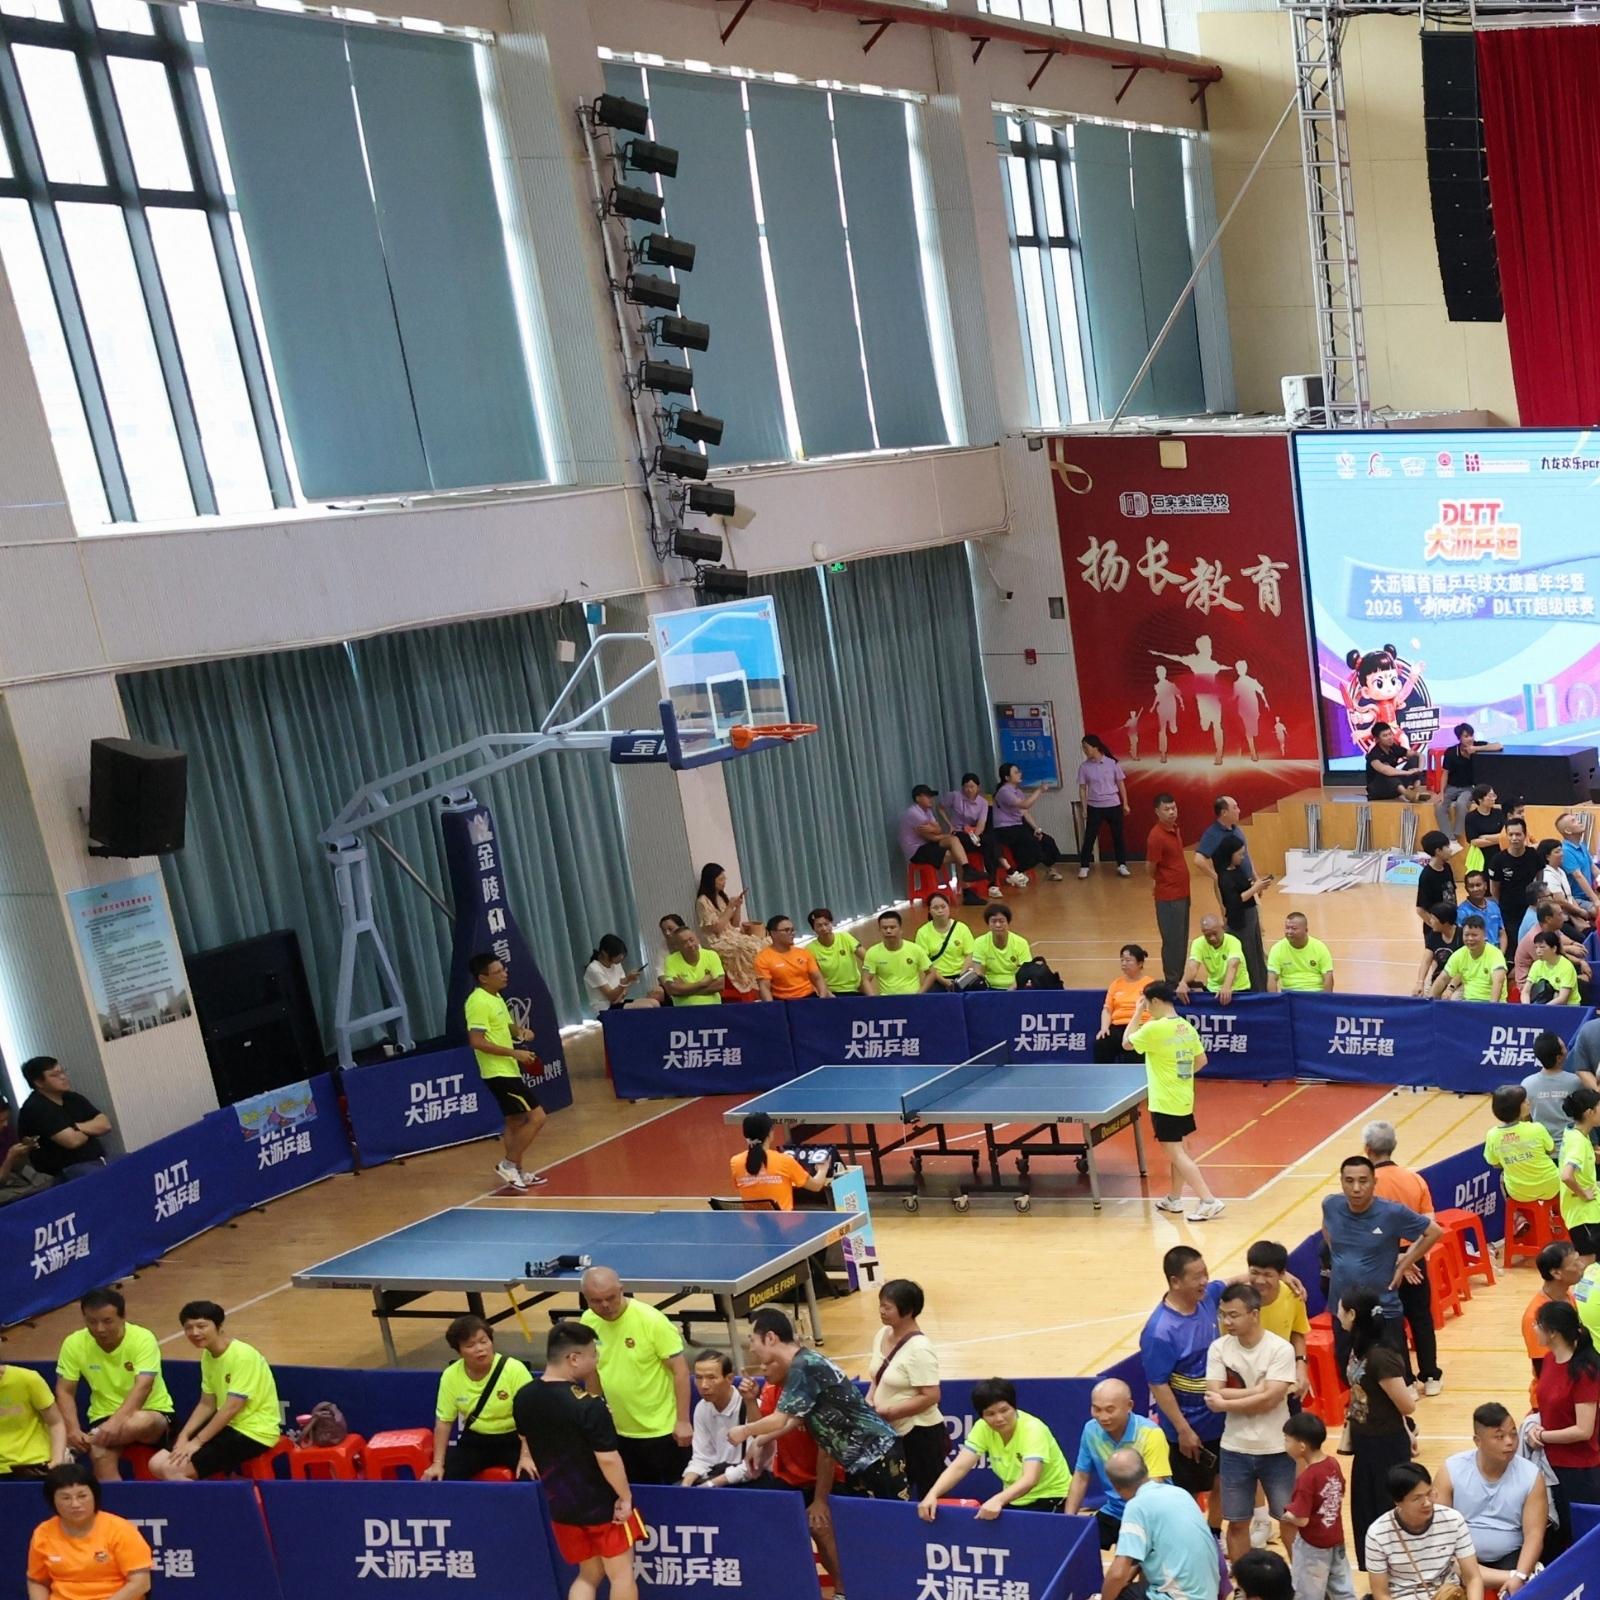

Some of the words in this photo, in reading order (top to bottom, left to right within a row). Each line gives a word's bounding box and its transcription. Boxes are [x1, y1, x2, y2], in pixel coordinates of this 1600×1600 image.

[1443, 503, 1501, 525] DLTT
[1427, 528, 1519, 558] 大沥乒超
[1077, 536, 1289, 617] 扬长教育
[1370, 573, 1585, 594] 大沥镇首届乒乓球文旅嘉年华暨
[1365, 599, 1403, 616] 2026
[1493, 598, 1595, 617] DLTT超级联赛
[1013, 740, 1036, 752] 119
[852, 1019, 907, 1038] DLTT
[1021, 1014, 1074, 1031] DLTT
[1336, 1017, 1384, 1035] DLTT
[671, 1029, 728, 1048] DLTT
[845, 1038, 920, 1059] 大沥乒超
[1014, 1033, 1086, 1051] 大沥乒超
[1328, 1036, 1394, 1056] 大沥乒超
[663, 1048, 741, 1069] 大沥乒超
[411, 1074, 463, 1103] DLTT
[405, 1093, 478, 1126] 大沥乒超
[258, 1131, 311, 1170] 大沥乒超
[812, 1149, 829, 1164] 6
[155, 1160, 188, 1195] DLTT
[155, 1180, 200, 1222] 大沥乒超
[35, 1213, 76, 1251] DLTT
[31, 1233, 89, 1279] 大沥乒超
[780, 1273, 797, 1291] FISH
[860, 1262, 878, 1283] T
[365, 1519, 451, 1546] DLTT
[356, 1550, 476, 1578] 大沥乒超
[926, 1544, 1009, 1575] DLTT
